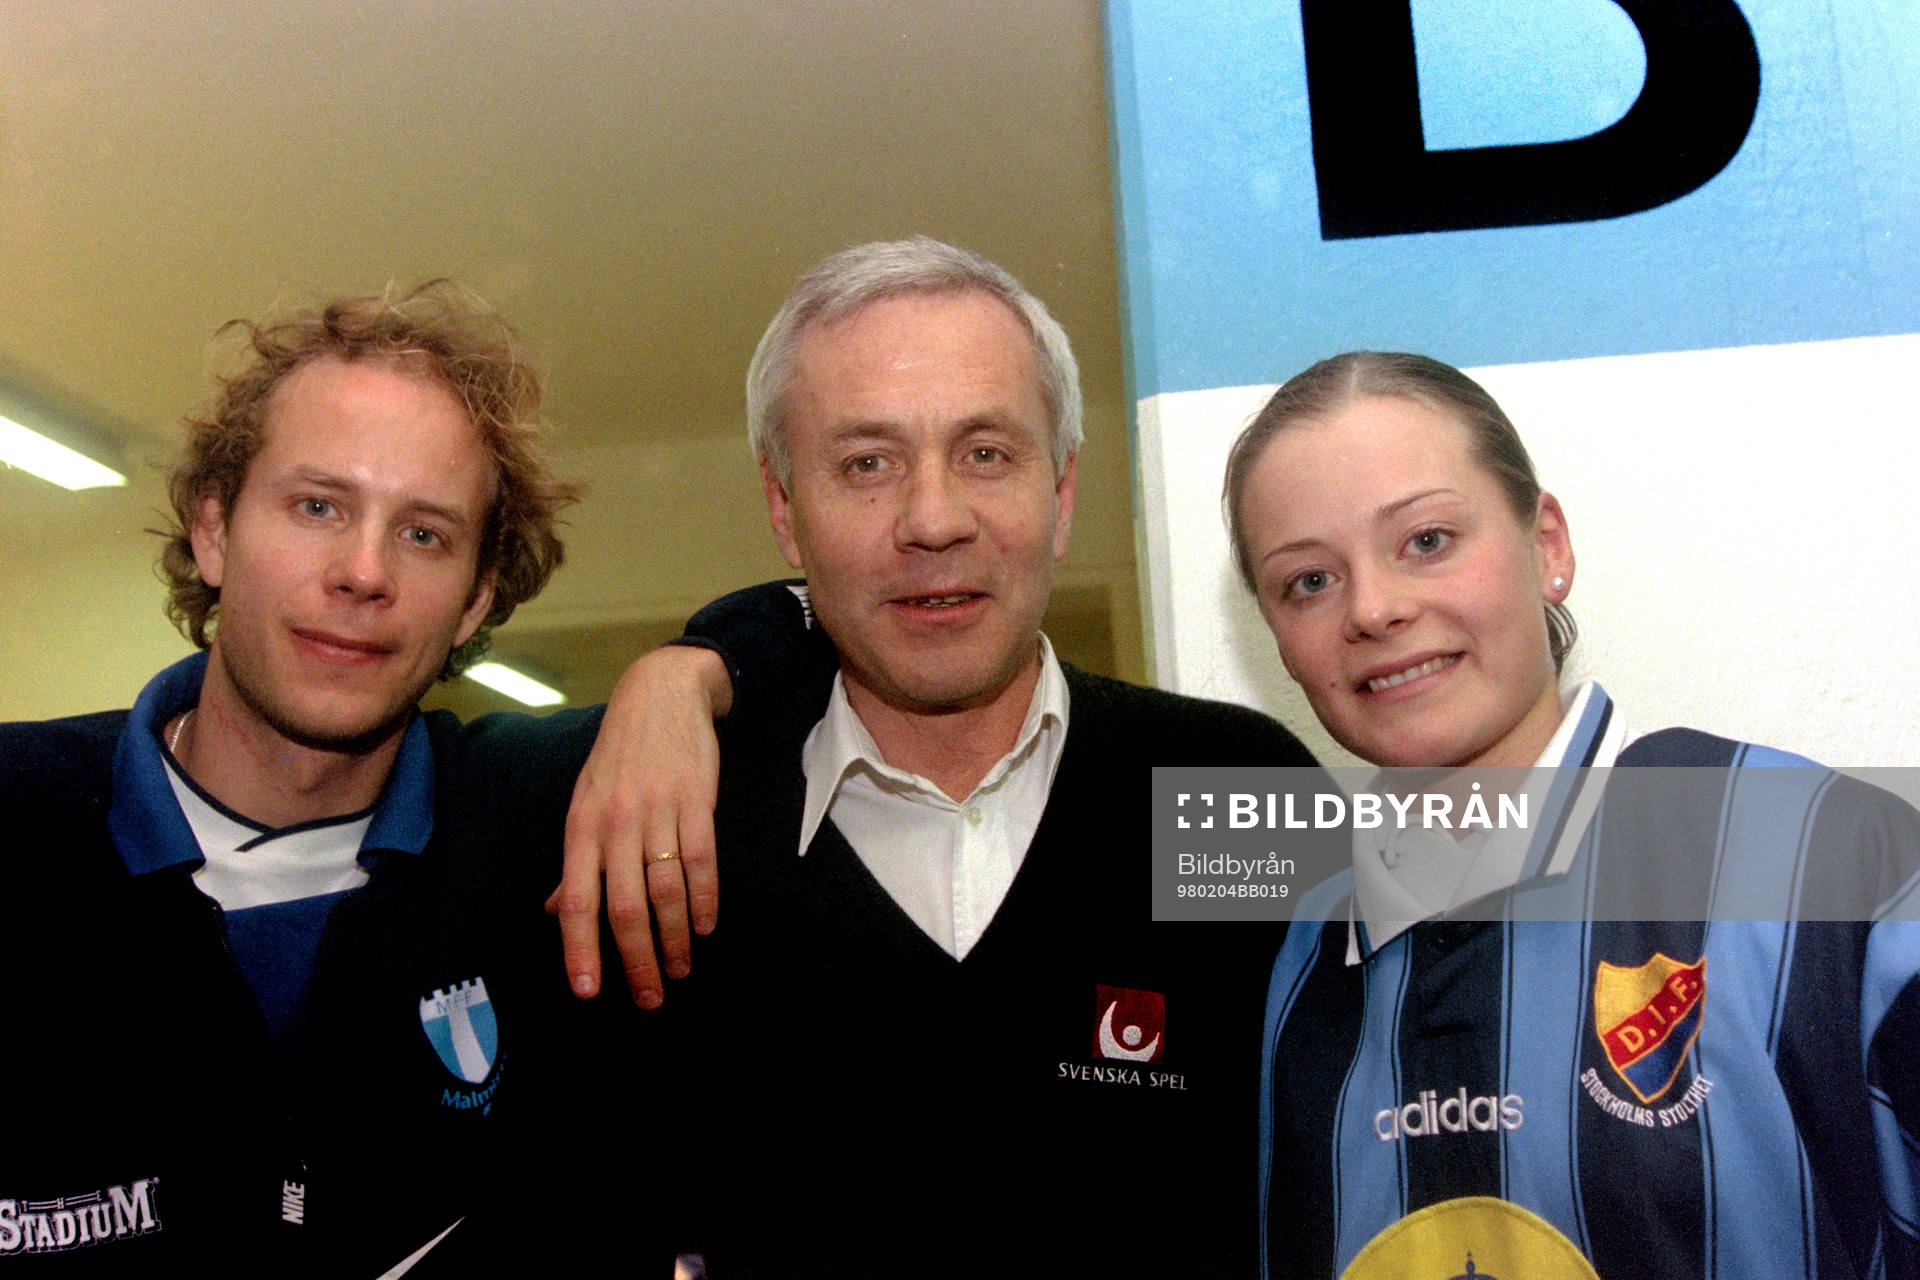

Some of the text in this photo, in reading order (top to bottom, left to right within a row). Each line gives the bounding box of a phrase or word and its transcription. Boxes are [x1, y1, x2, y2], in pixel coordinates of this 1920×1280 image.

[1057, 1062, 1188, 1091] SVENSKA SPEL
[1580, 1067, 1714, 1128] STOCKHOLMS STOLTHET
[1373, 1087, 1524, 1142] adidas
[0, 1178, 160, 1254] STADIUM
[281, 1179, 305, 1225] NIKE
